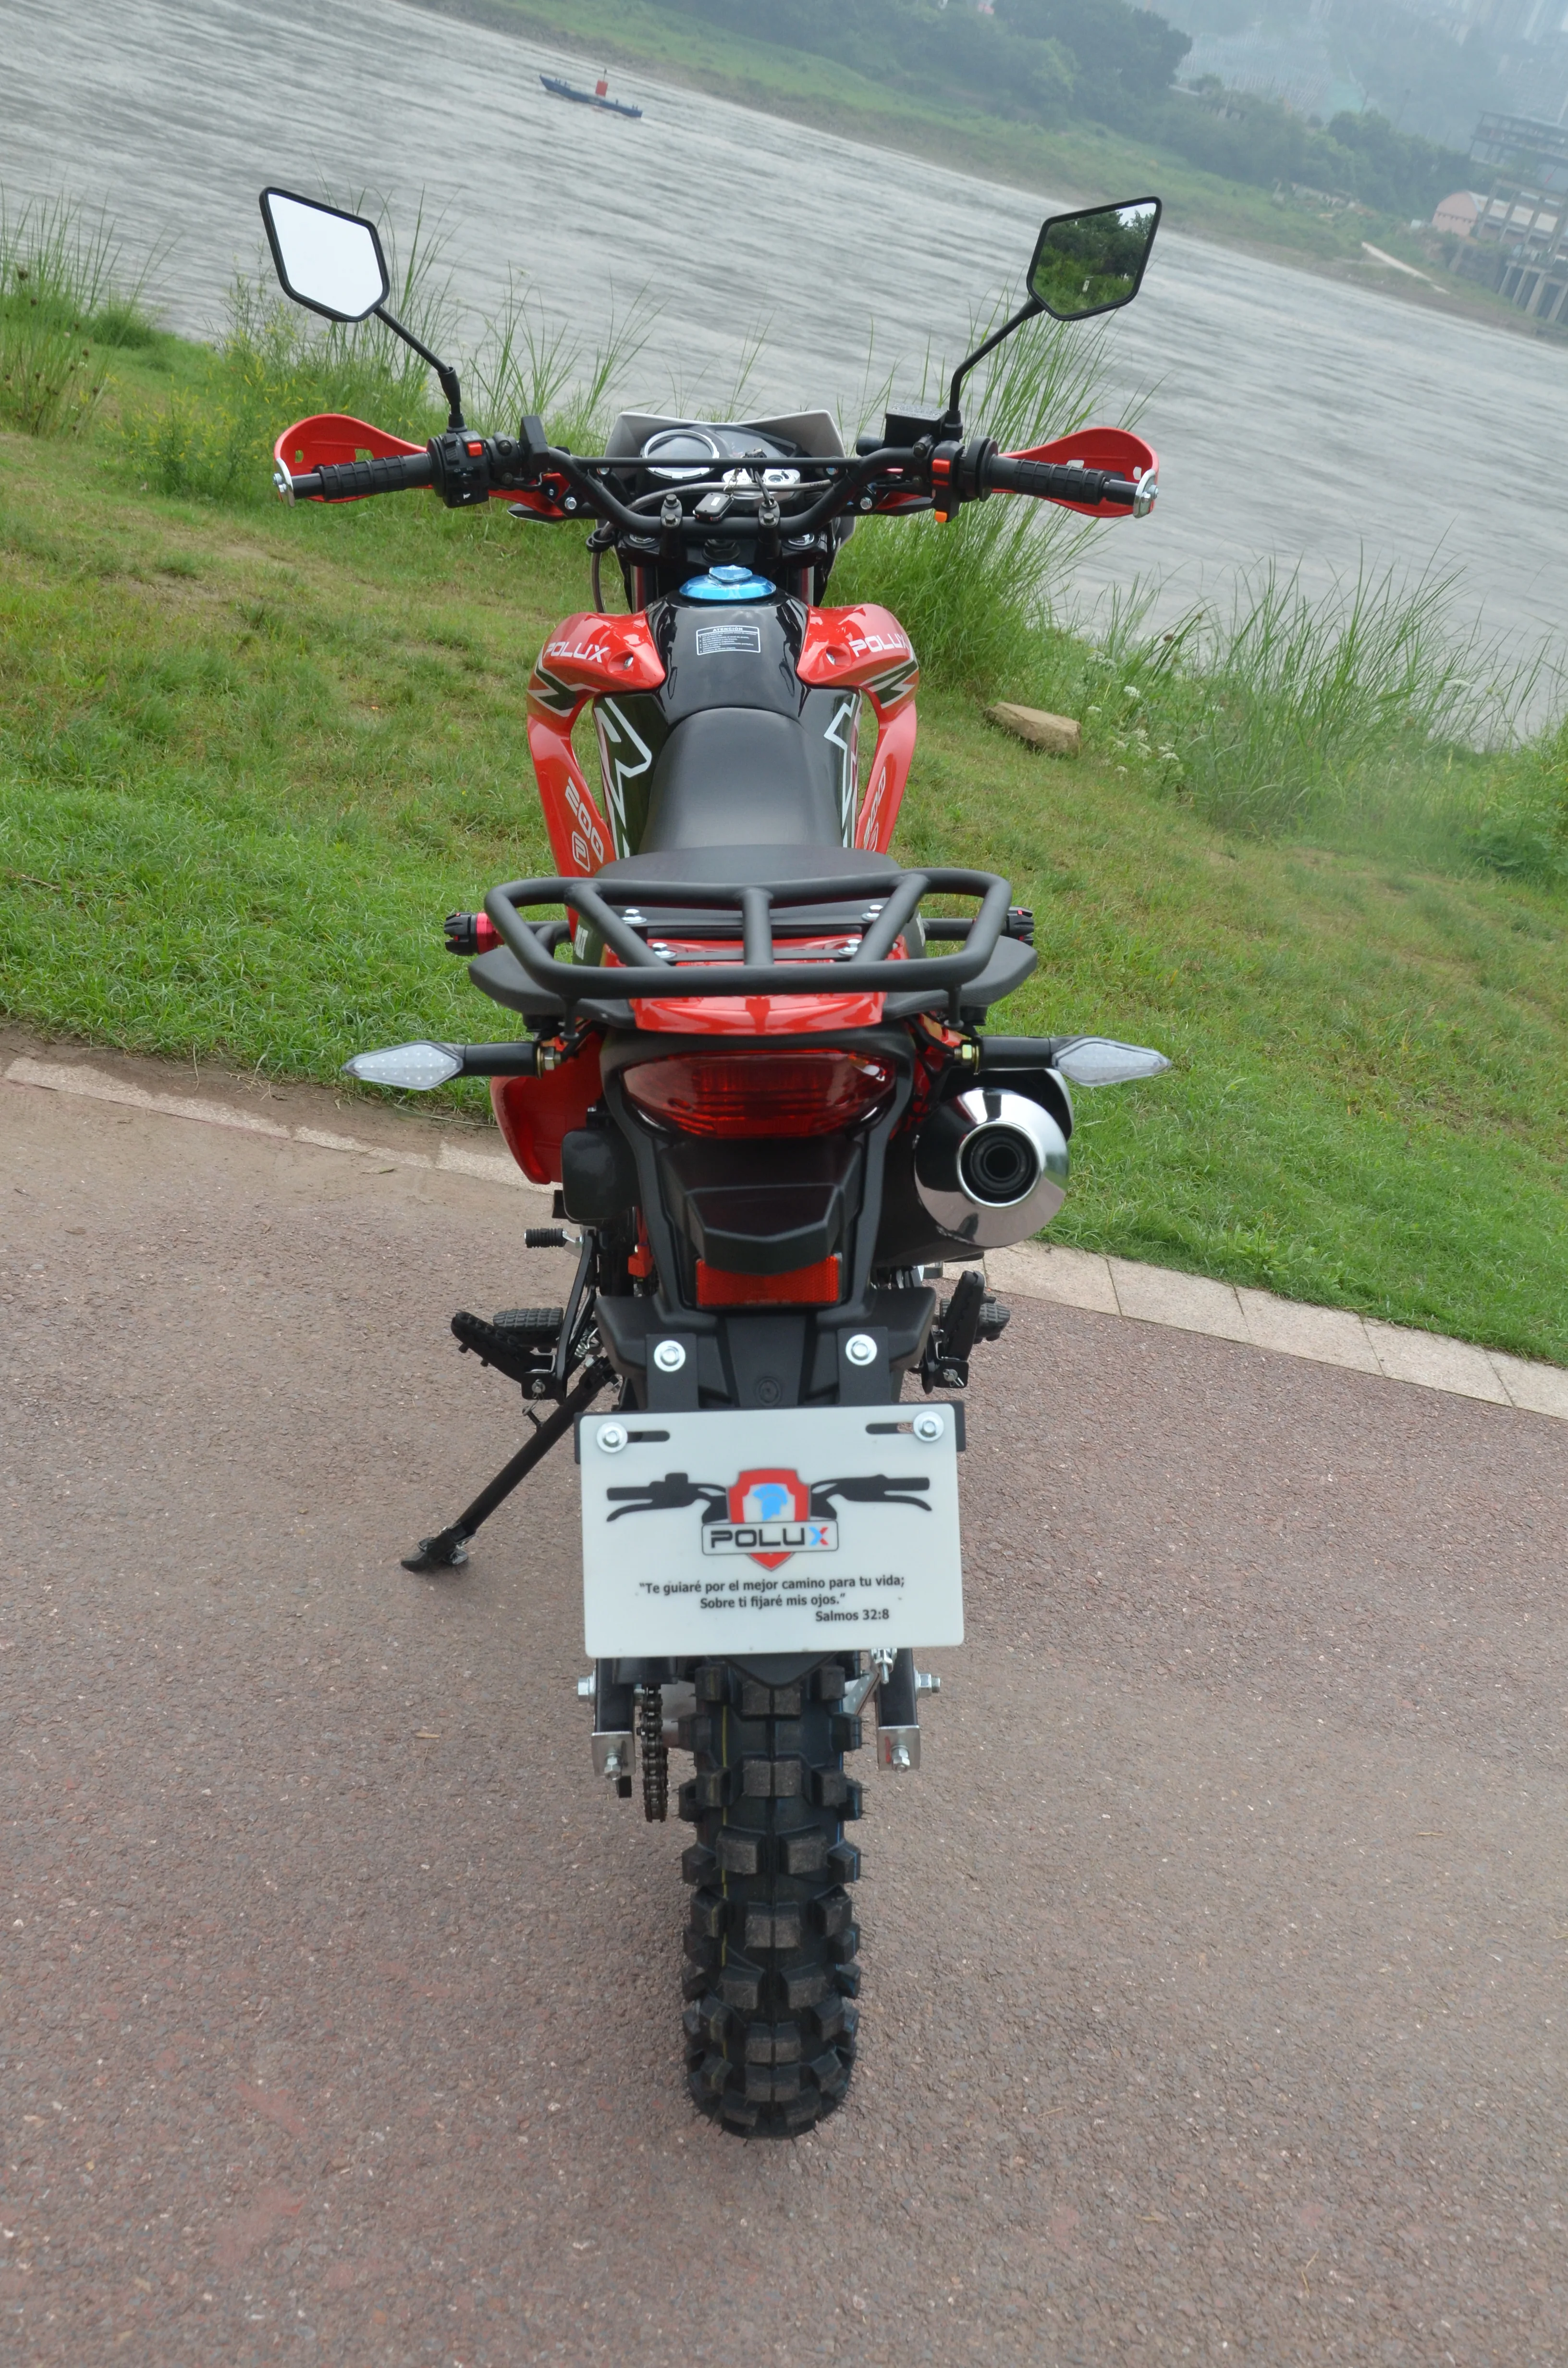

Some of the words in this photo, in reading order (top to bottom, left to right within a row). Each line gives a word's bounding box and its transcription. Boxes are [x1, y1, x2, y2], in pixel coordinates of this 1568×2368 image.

[543, 641, 610, 663] POLUX
[850, 633, 909, 657] POLUX
[565, 776, 604, 863] 200
[710, 1526, 829, 1548] POLUX
[663, 1580, 701, 1596] guiaré
[705, 1583, 725, 1594] por
[728, 1580, 739, 1591] el
[743, 1579, 778, 1593] mejor
[782, 1578, 825, 1590] camino
[829, 1579, 856, 1590] para
[859, 1577, 871, 1587] tu
[876, 1575, 904, 1587] vida;
[700, 1597, 735, 1609] Sobre
[738, 1596, 747, 1607] ti
[750, 1595, 783, 1610] fijaré
[786, 1594, 808, 1606] mis
[815, 1611, 859, 1622] Salmos
[863, 1609, 889, 1620] 32:8
